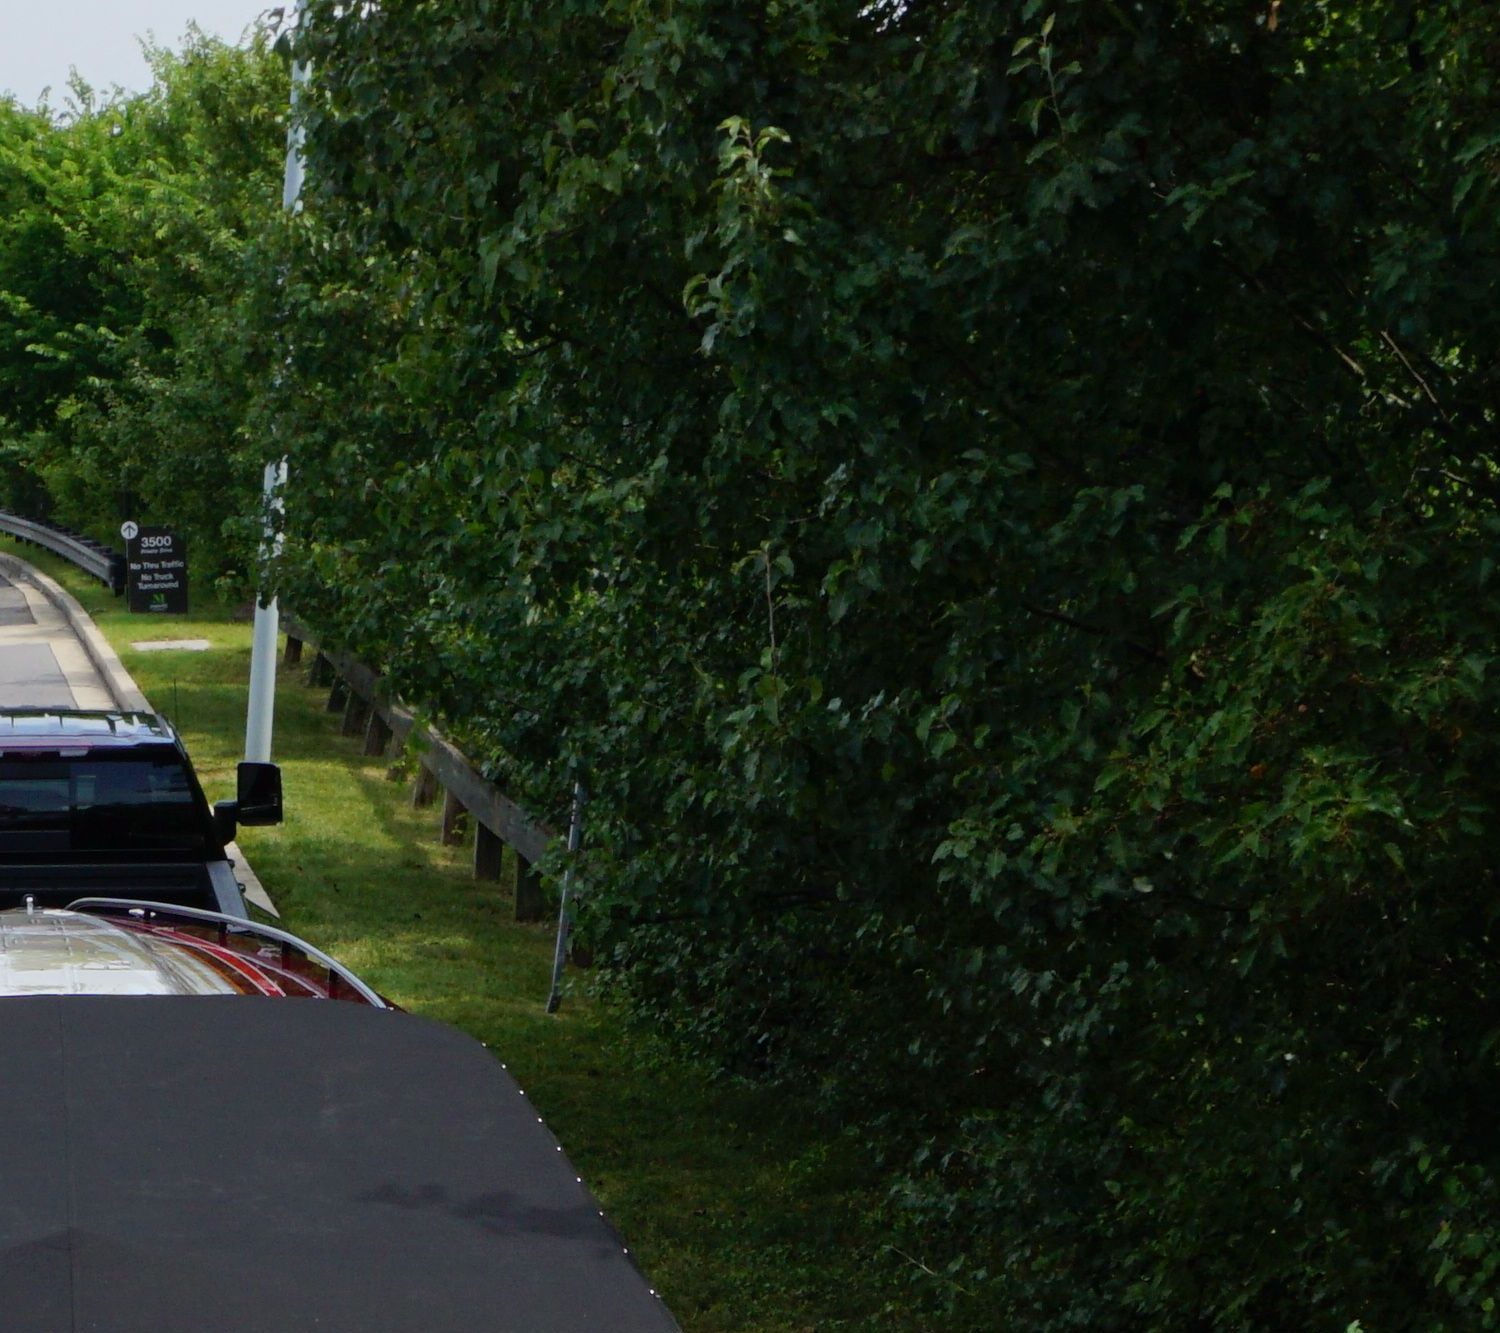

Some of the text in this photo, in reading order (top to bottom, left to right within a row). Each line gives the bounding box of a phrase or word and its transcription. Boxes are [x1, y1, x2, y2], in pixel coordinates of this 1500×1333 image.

[141, 536, 171, 547] 3500
[130, 560, 184, 570] No Thru Traffic
[141, 573, 152, 581] No
[138, 581, 178, 589] Turnaround
